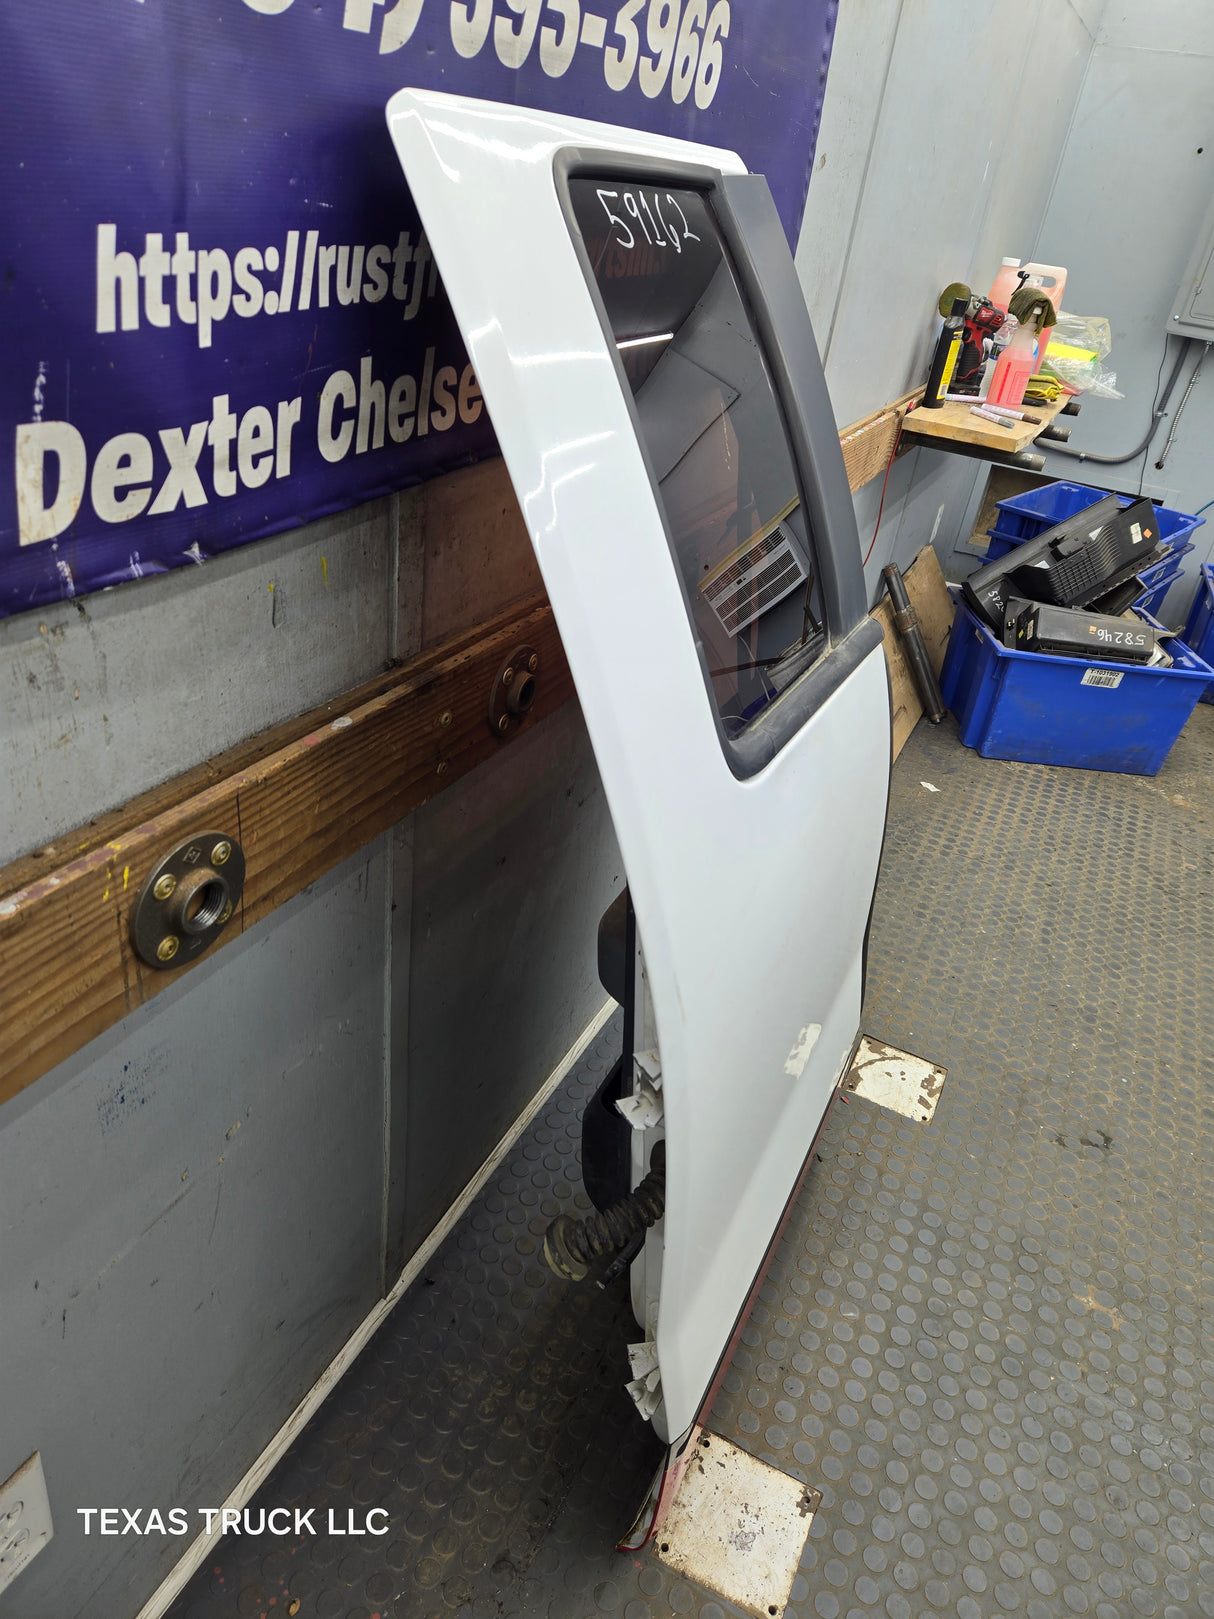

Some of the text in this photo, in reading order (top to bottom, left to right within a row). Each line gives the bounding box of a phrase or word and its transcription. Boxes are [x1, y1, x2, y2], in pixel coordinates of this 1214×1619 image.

[596, 189, 701, 254] 59162
[15, 346, 483, 547] Dexter Chelse
[1097, 629, 1147, 646] 58246
